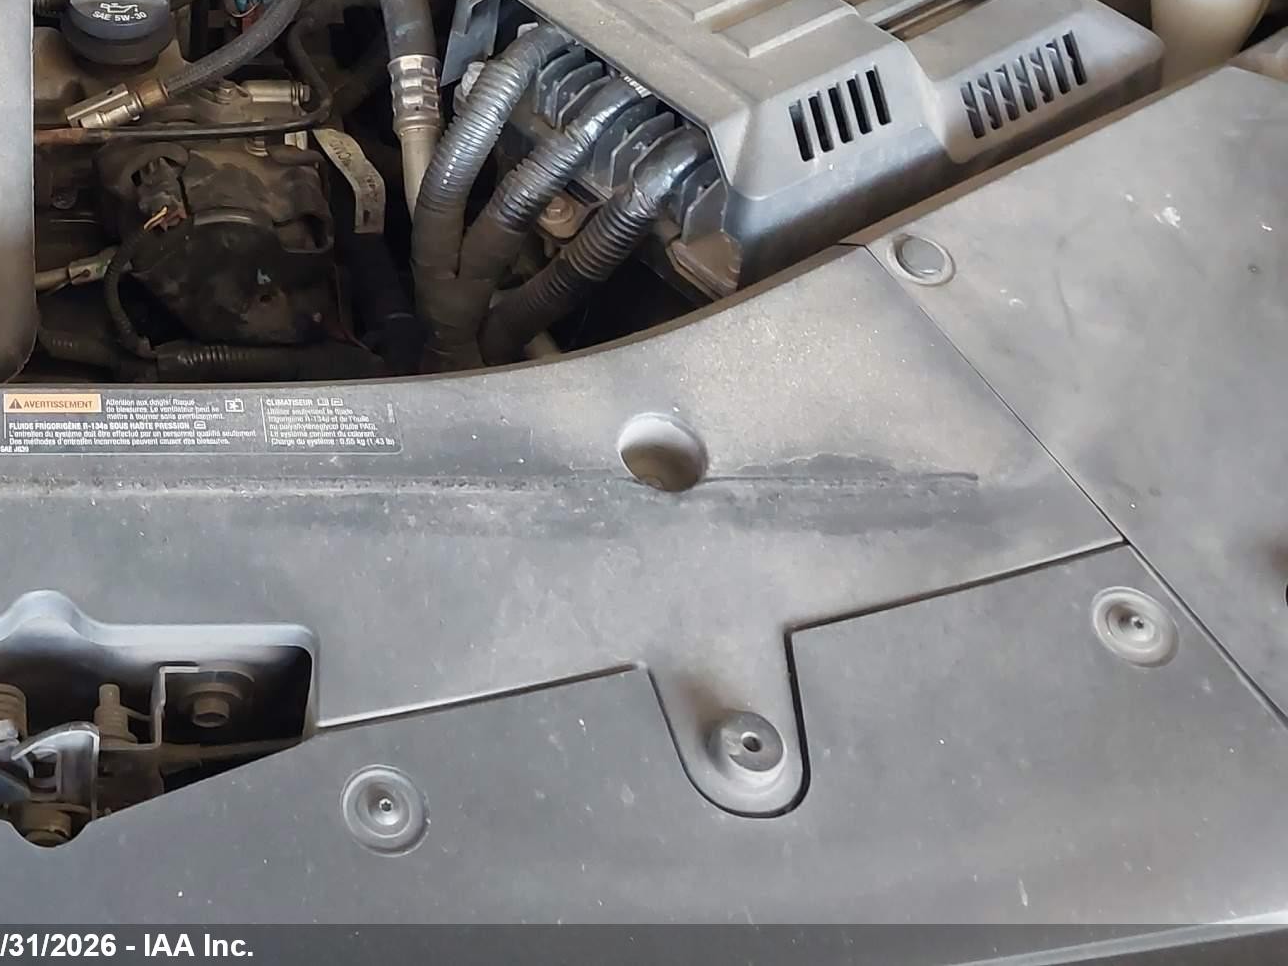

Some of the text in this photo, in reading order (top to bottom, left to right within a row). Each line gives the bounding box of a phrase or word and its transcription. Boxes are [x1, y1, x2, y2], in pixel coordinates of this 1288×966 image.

[92, 11, 147, 22] SAE 5W-30
[24, 400, 93, 409] AVERTISSEMENT
